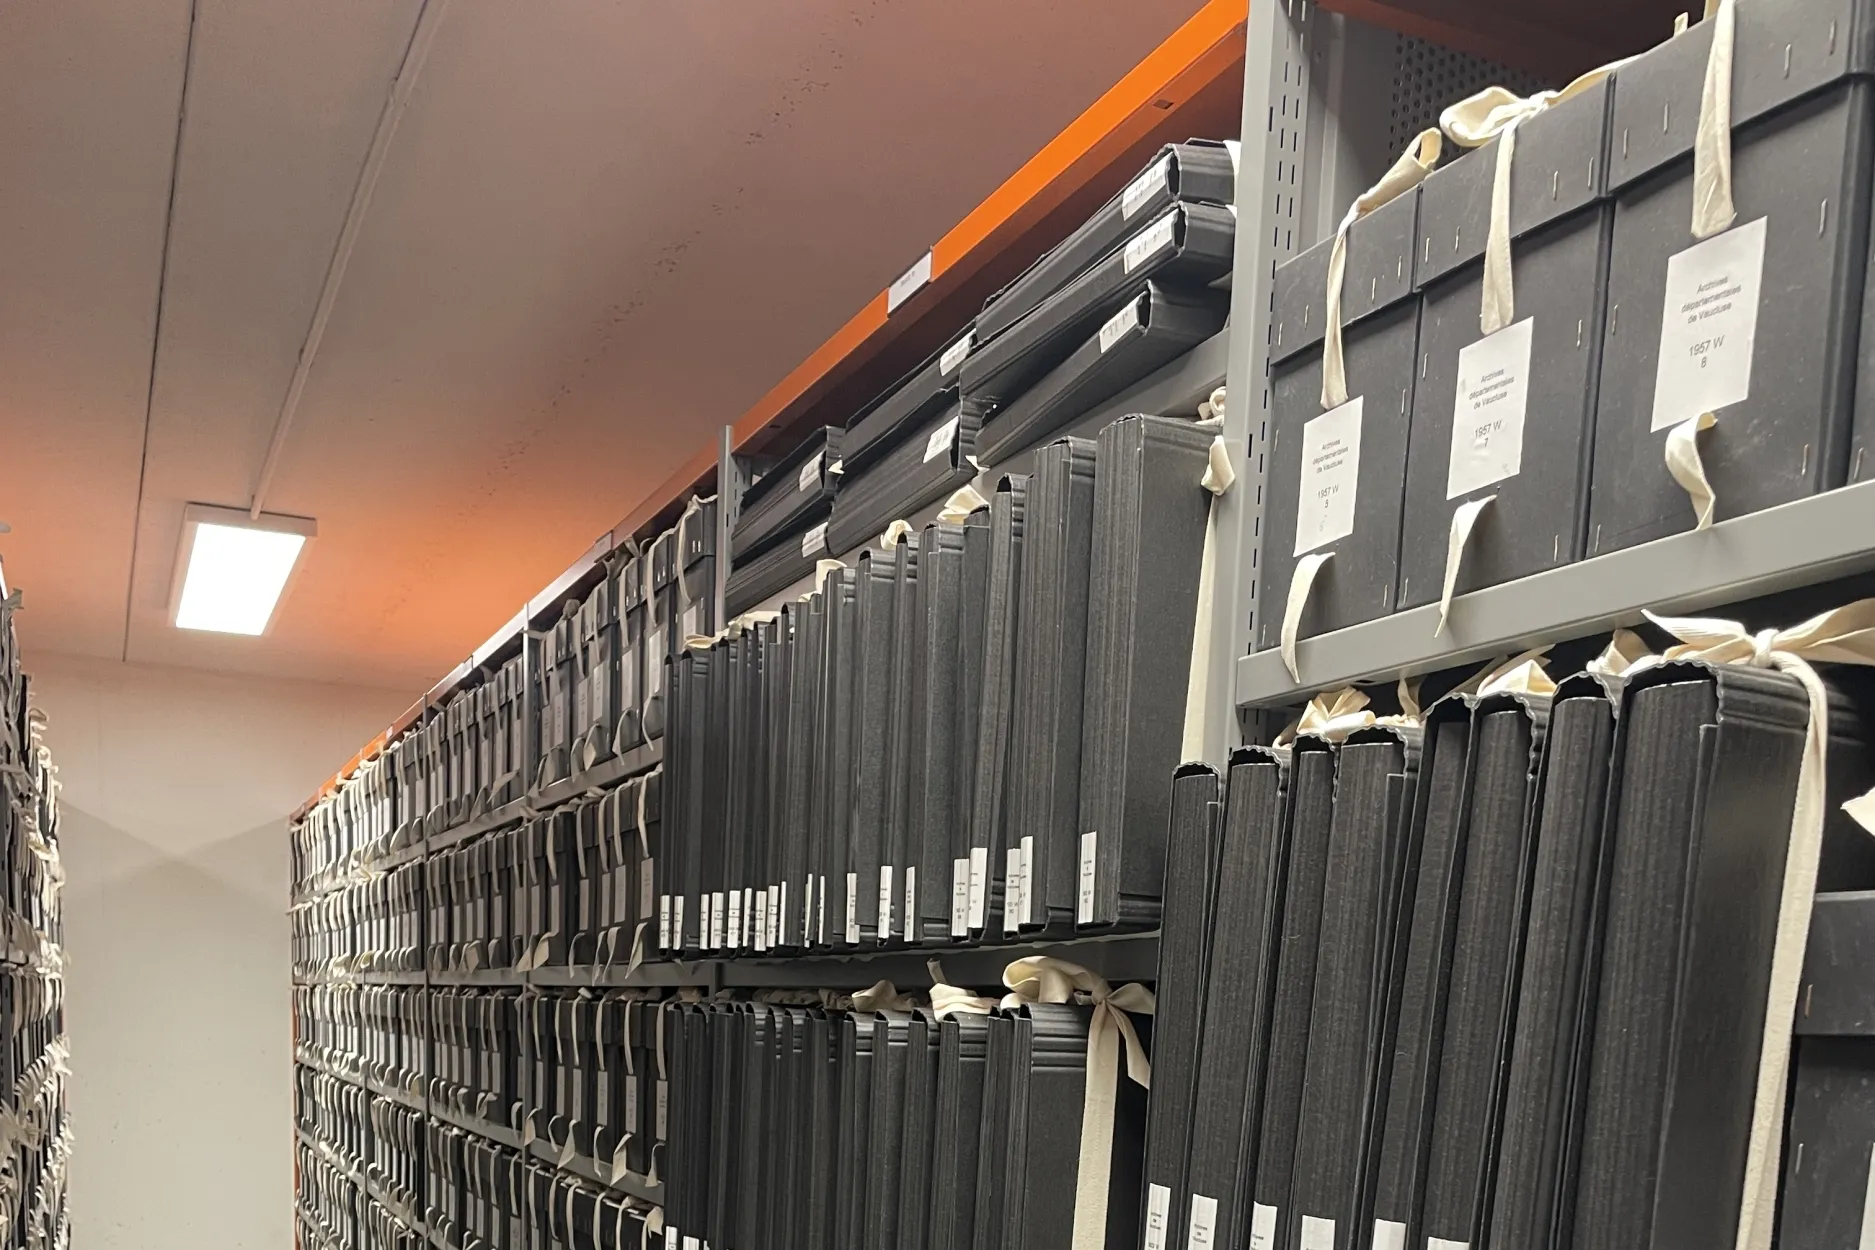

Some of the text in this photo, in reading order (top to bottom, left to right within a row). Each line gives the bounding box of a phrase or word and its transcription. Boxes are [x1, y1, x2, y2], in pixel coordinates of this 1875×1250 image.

[1687, 302, 1732, 324] de Vaucluse
[1689, 334, 1725, 357] 1957 W
[1700, 356, 1707, 369] 8
[1474, 419, 1502, 439] 1957 W
[1317, 483, 1340, 499] 1957 W
